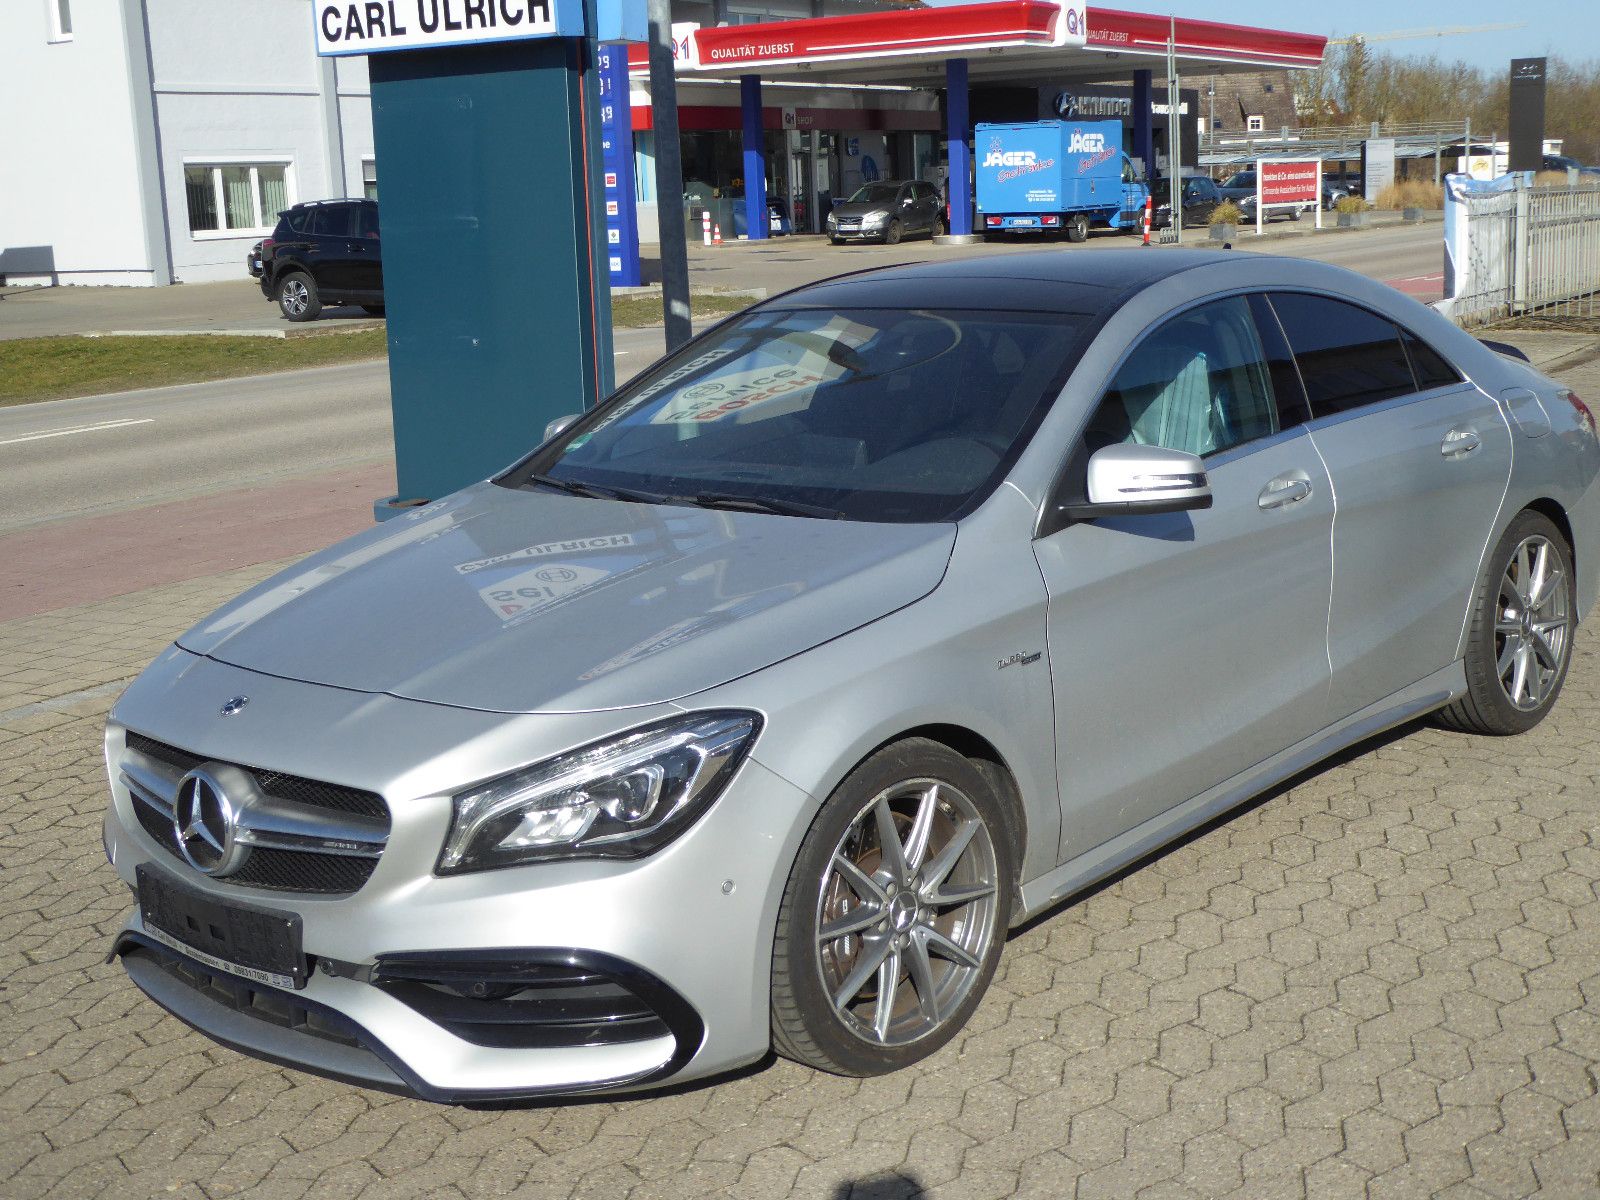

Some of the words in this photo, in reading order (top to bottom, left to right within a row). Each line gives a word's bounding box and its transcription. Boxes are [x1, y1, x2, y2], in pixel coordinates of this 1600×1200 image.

[321, 1, 407, 43] CARL
[417, 0, 550, 34] ULRICH
[1066, 8, 1086, 36] Q1
[1109, 31, 1129, 42] ZUERST
[711, 45, 756, 59] QUALITÄT
[758, 43, 794, 55] ZUERST
[1067, 128, 1105, 153] JÄGER
[982, 149, 1037, 168] JÄGER
